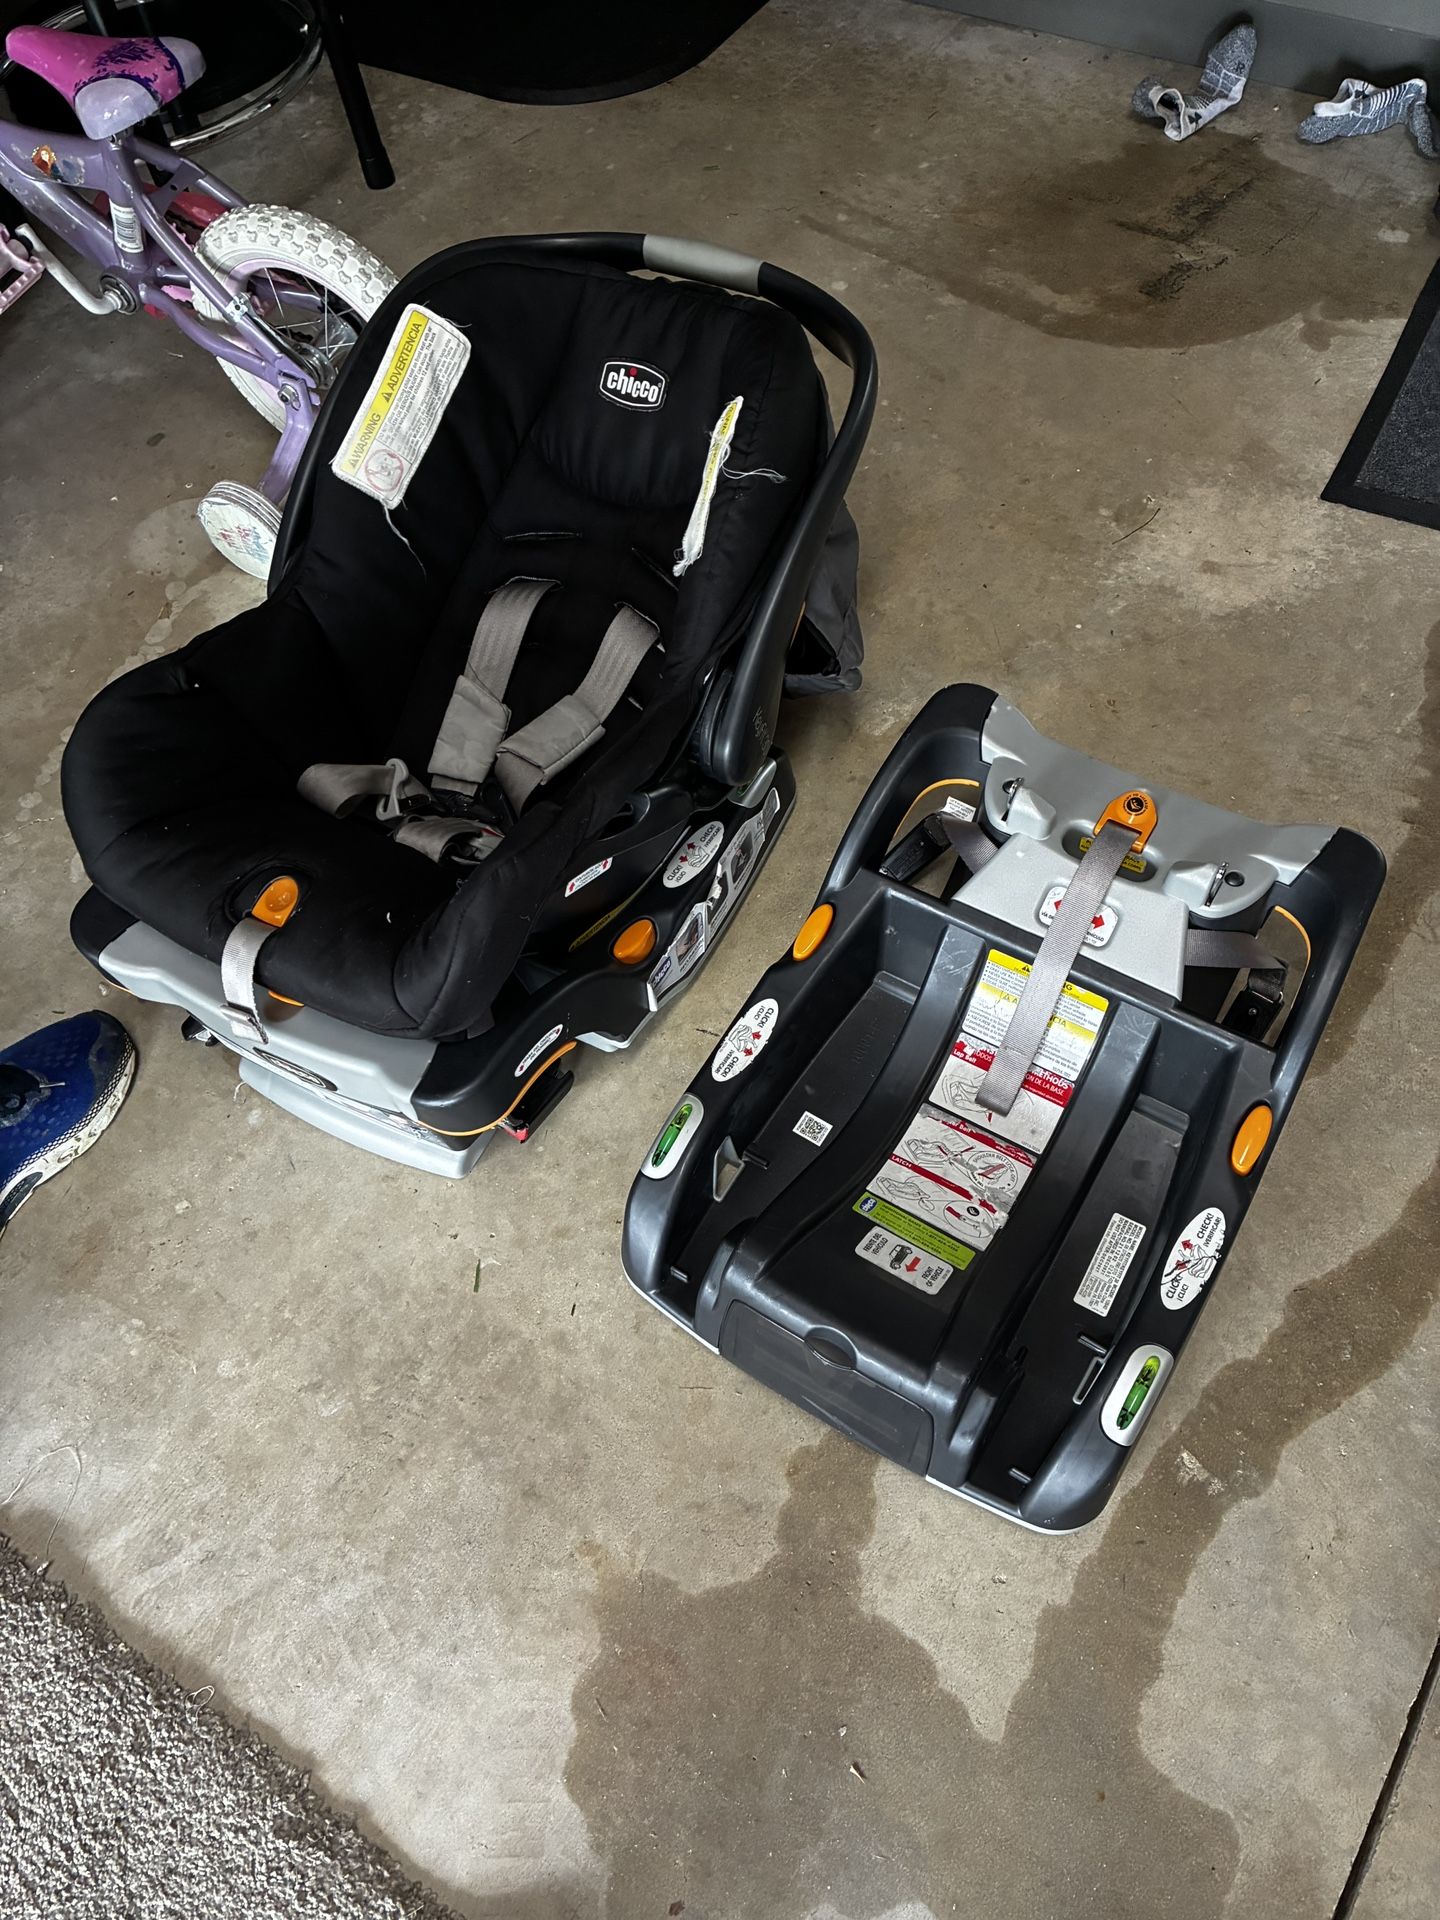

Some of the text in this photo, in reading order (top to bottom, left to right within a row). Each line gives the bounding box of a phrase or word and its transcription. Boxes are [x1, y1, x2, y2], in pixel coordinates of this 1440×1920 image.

[386, 320, 422, 391] ADVERTENCIA
[606, 366, 659, 403] chicco
[351, 411, 381, 460] WARNING
[665, 863, 683, 882] CLICK!
[756, 1006, 775, 1028] CLICK!
[720, 1055, 739, 1078] CHECK!
[1032, 1076, 1043, 1086] DE
[1041, 1080, 1051, 1090] LA
[1048, 1084, 1065, 1097] BASE
[890, 1154, 912, 1168] LATCH
[1195, 1211, 1214, 1240] CHECK!
[1202, 1215, 1222, 1247] ¡VERIFICAR!
[862, 1237, 877, 1252] FRENTE
[920, 1265, 934, 1279] FRONT
[925, 1266, 944, 1287] OF VEHICLE
[1164, 1273, 1183, 1299] CLICK!
[1175, 1283, 1190, 1302] ¡CLIC!
